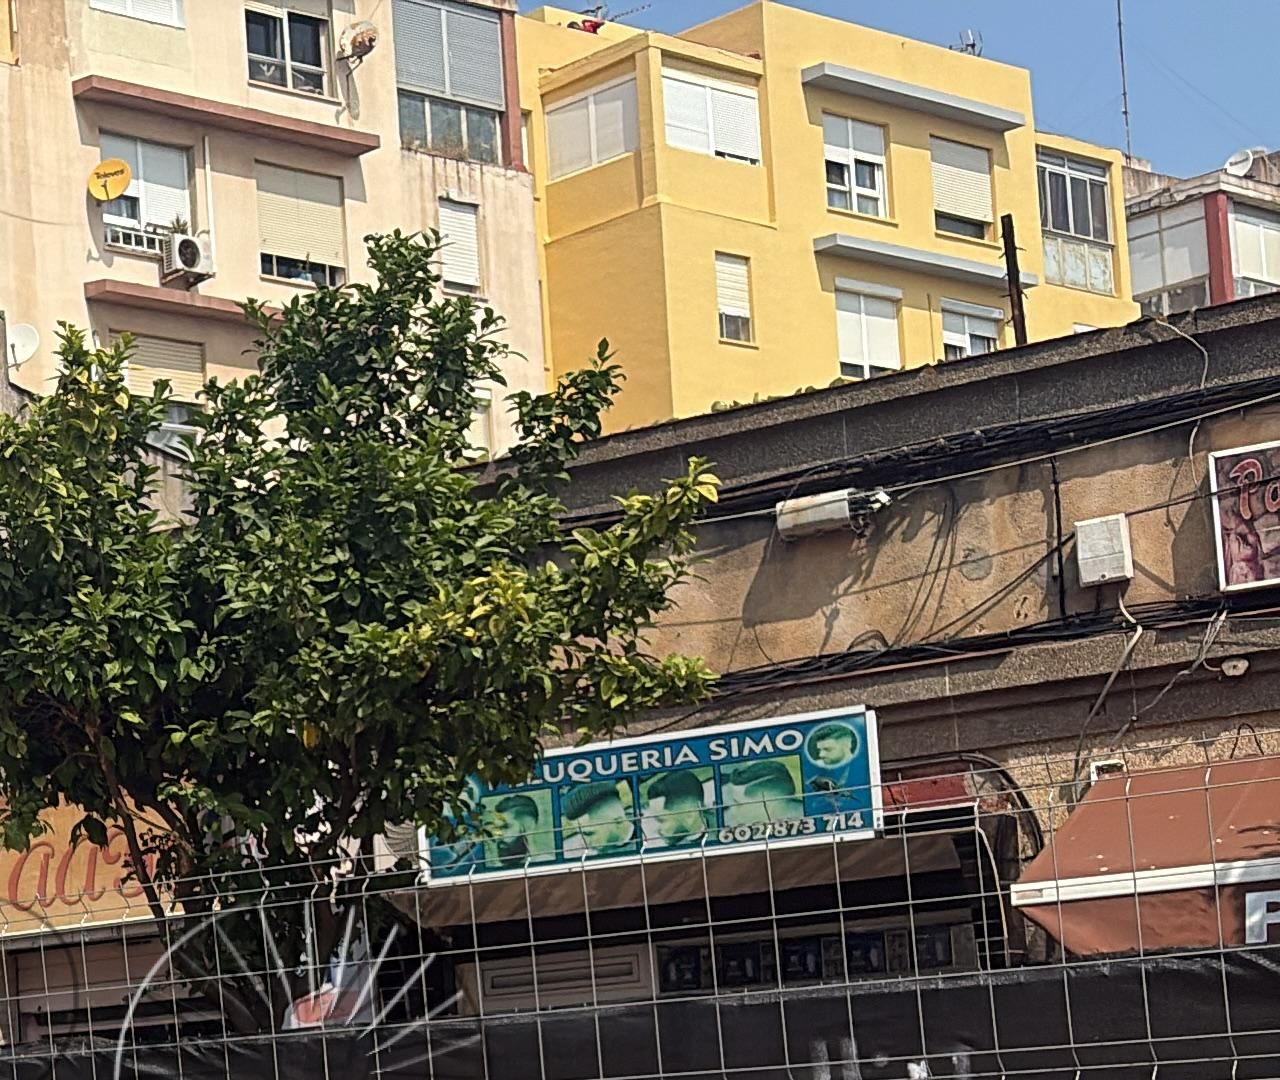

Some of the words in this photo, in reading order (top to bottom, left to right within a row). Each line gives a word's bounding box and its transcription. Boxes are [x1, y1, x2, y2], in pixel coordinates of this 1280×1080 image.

[709, 729, 804, 762] SIMO
[718, 822, 767, 844] 602
[822, 811, 864, 832] 714
